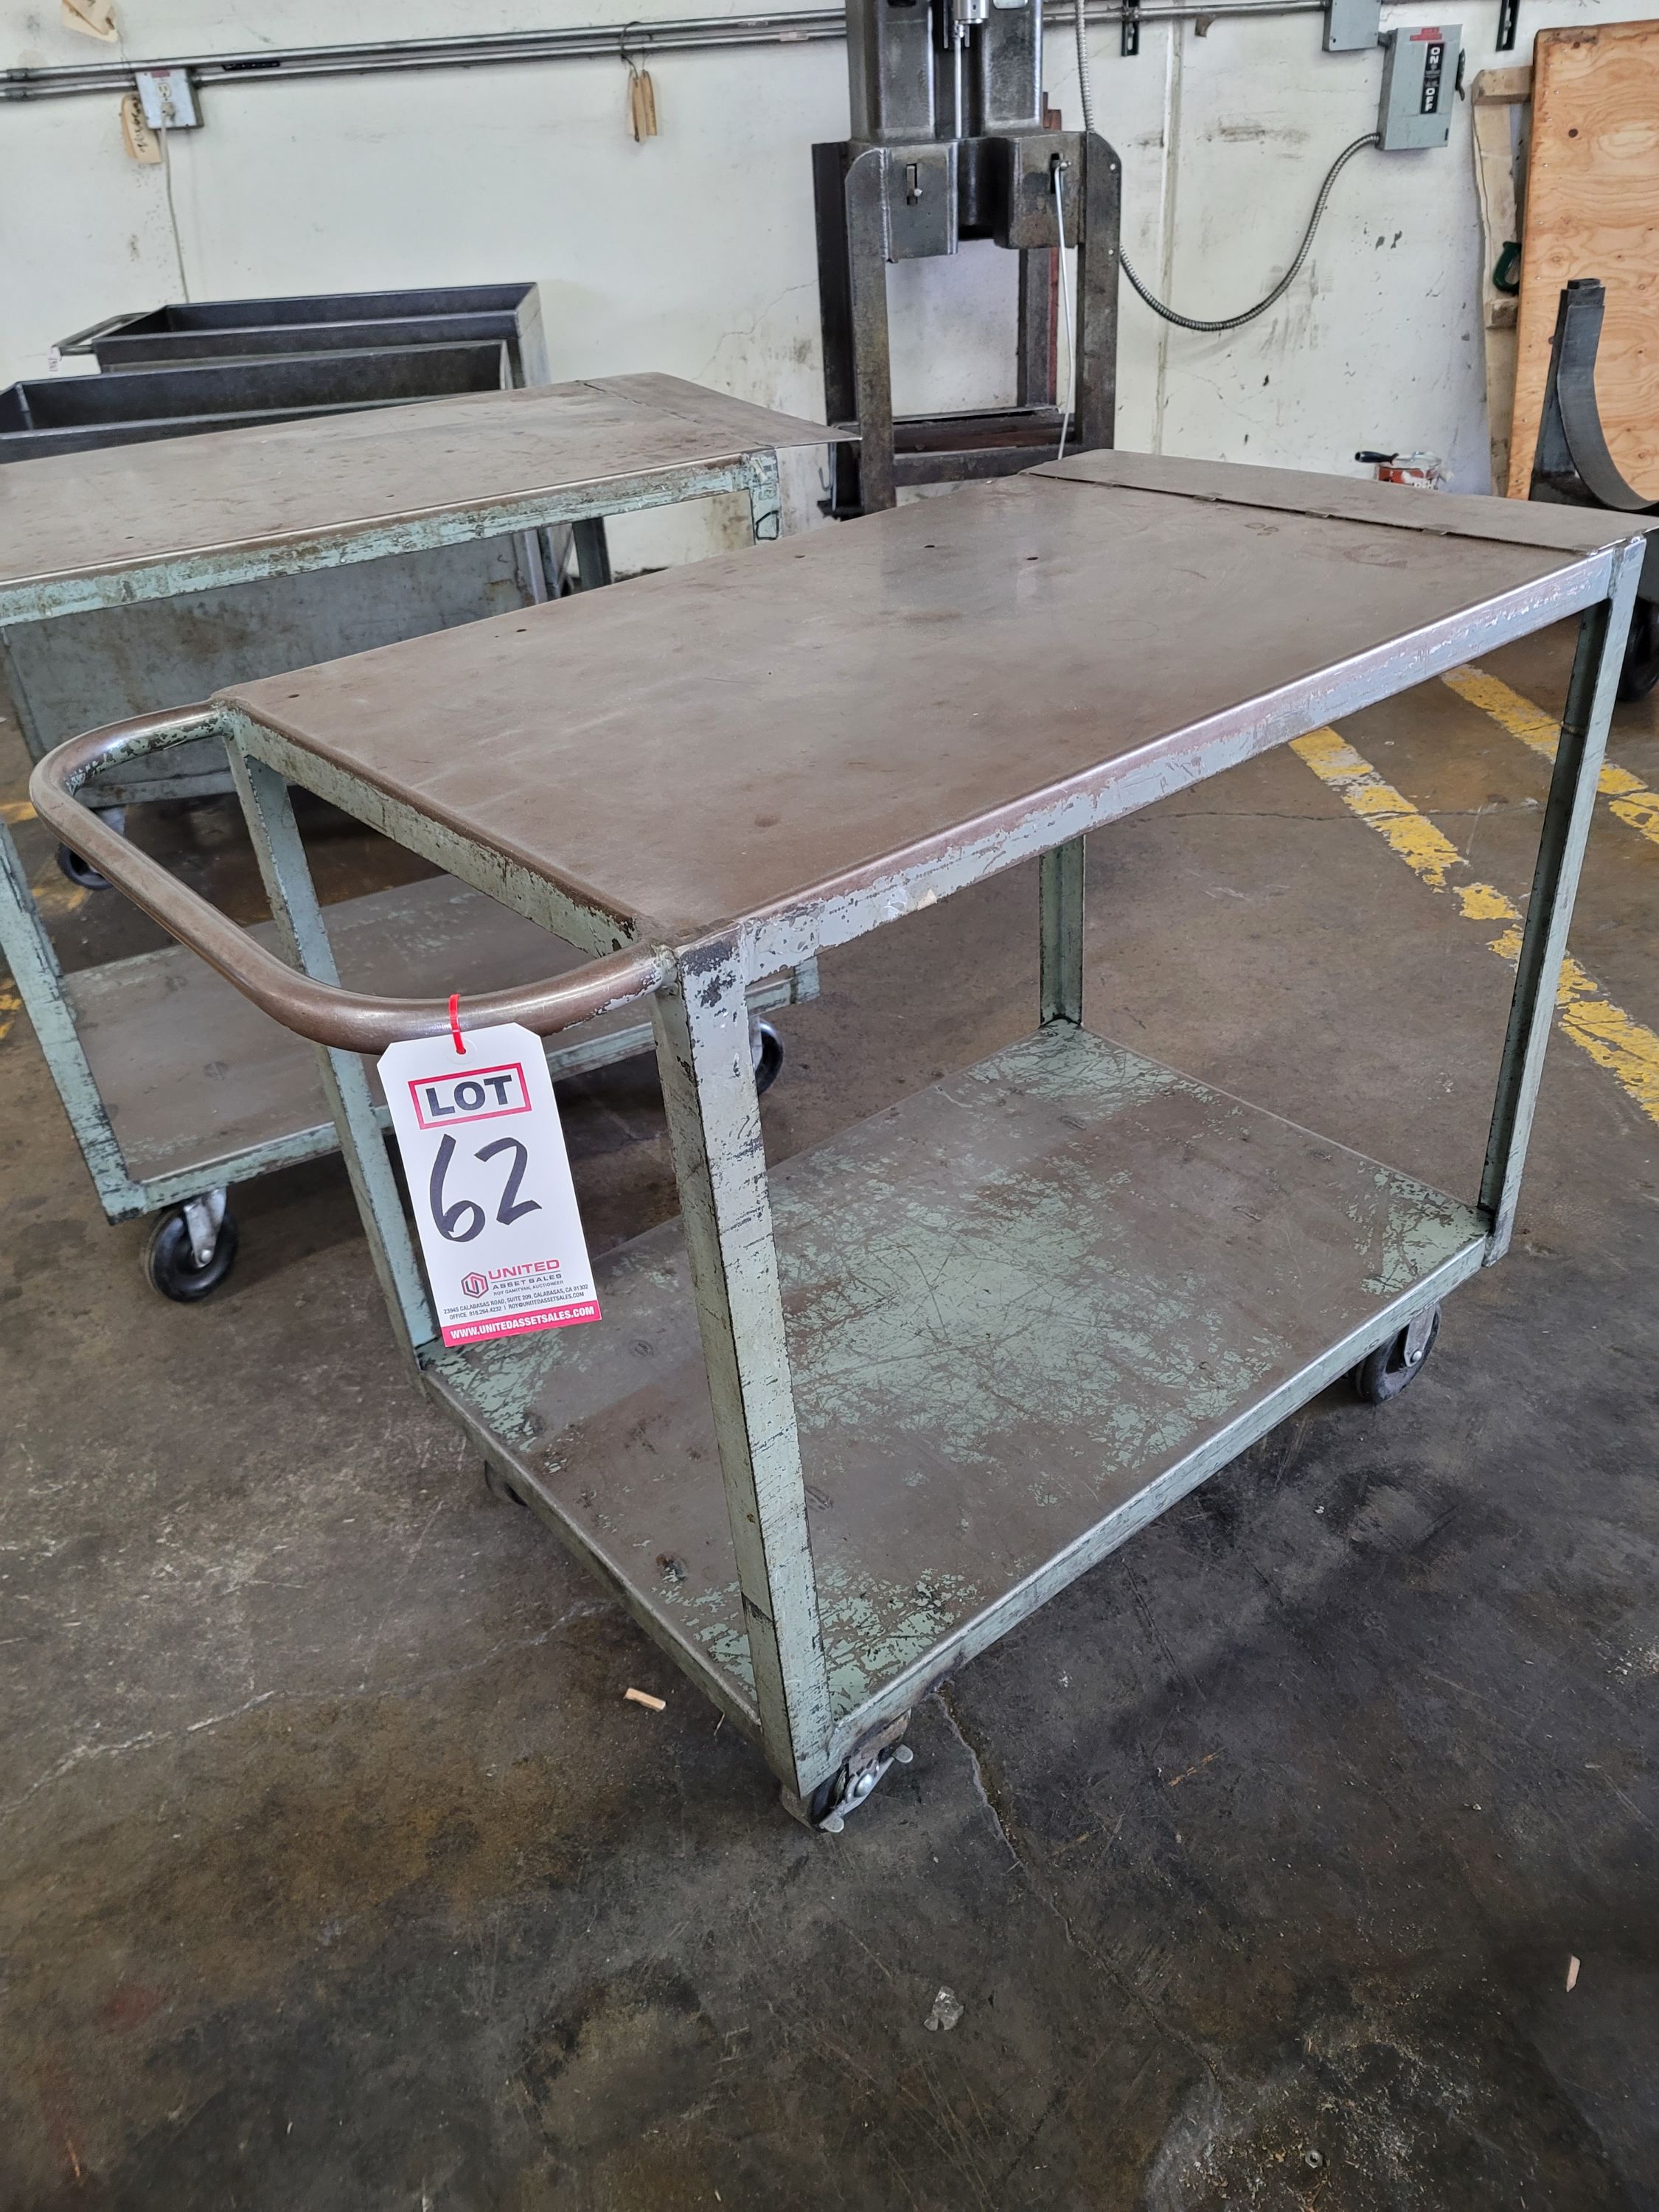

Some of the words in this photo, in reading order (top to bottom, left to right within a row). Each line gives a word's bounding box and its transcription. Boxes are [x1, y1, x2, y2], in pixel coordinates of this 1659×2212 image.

[1430, 46, 1441, 64] ON
[1425, 87, 1436, 111] OFF
[425, 1074, 512, 1116] LOT
[430, 1134, 542, 1242] 62
[487, 1259, 560, 1280] UNITED
[493, 1279, 526, 1290] ASSET
[529, 1273, 562, 1284] SALES
[532, 1280, 564, 1289] AUCTIONEER
[459, 1301, 490, 1311] CALABASAS
[534, 1288, 565, 1298] CALABASAS,
[509, 1292, 585, 1309] ROY@UNITEDASSETSALES.COM
[451, 1306, 595, 1340] WWW.UNITEDASSETSALES.COM
